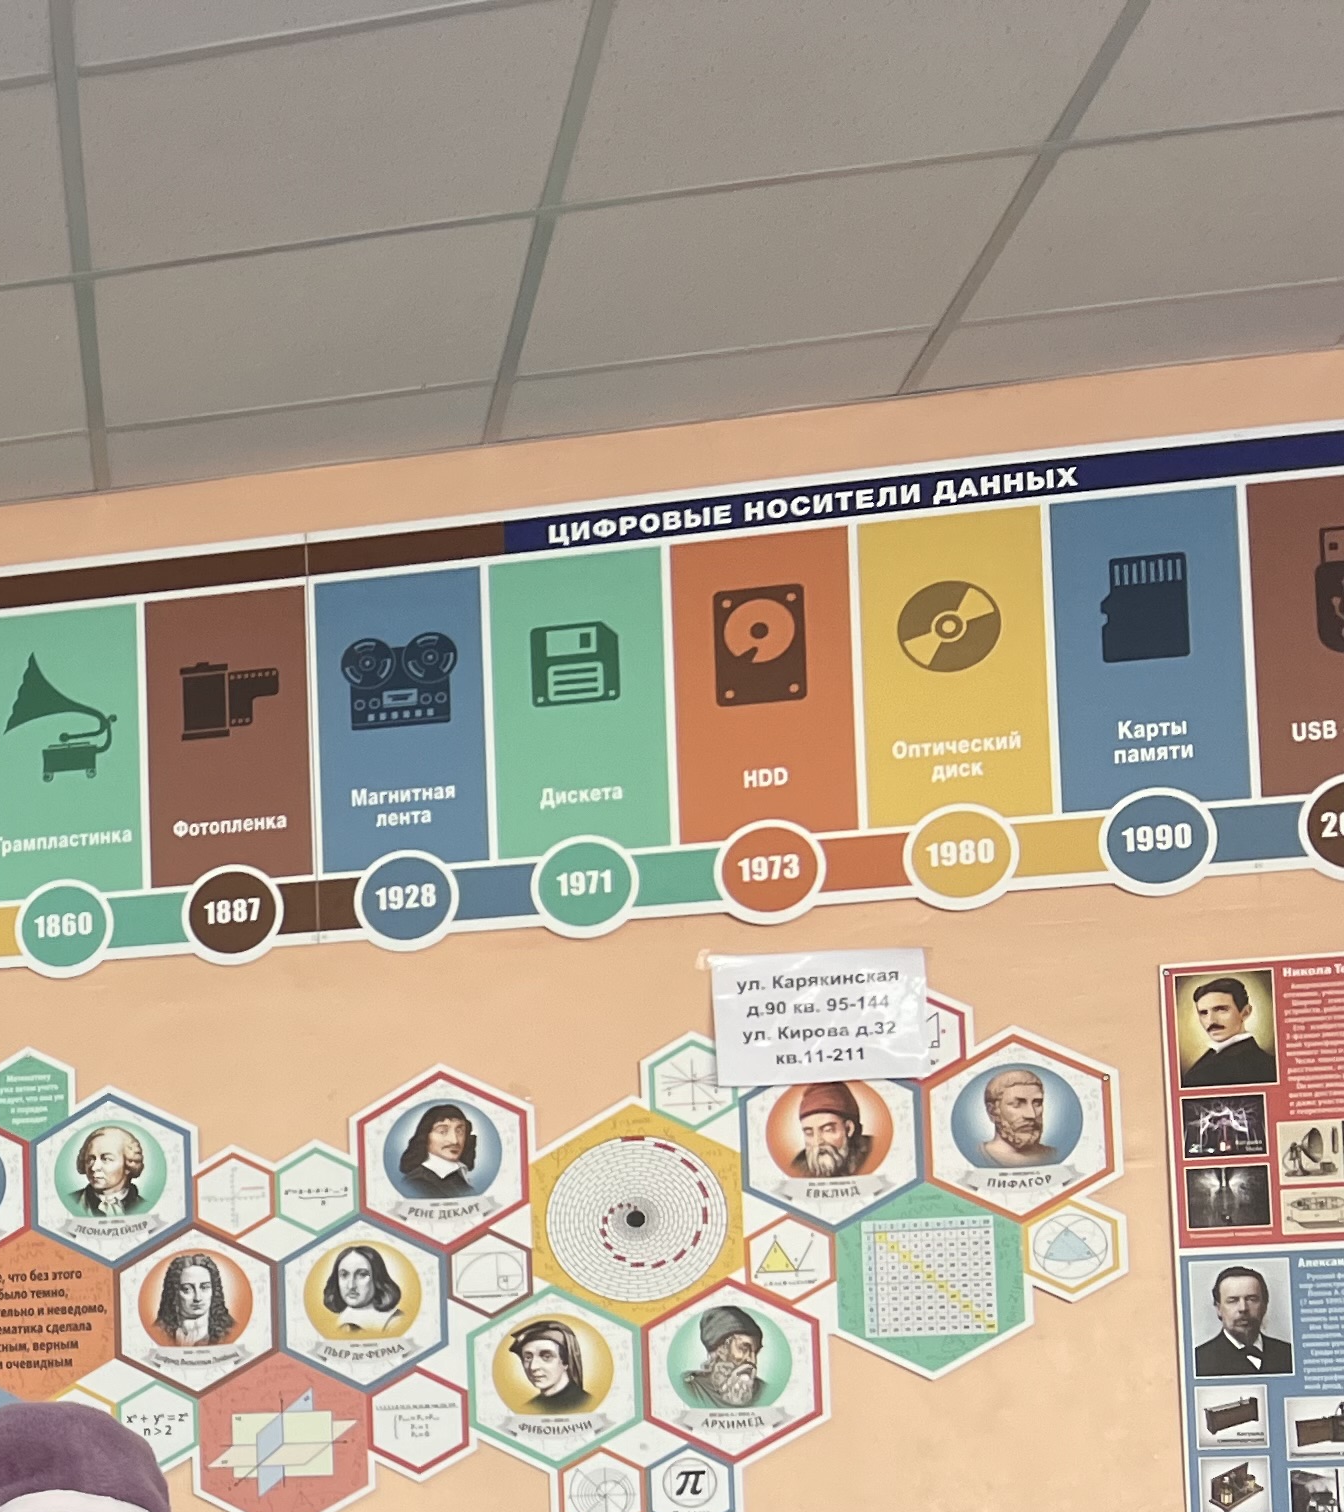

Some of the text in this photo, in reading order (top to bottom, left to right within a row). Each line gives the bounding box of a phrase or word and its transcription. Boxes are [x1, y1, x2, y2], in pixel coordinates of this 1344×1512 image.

[548, 466, 1079, 546] ЦИФРОВЫЕ НОСИТЕЛИ ДАННЫХ
[1117, 720, 1188, 743] Карты
[1291, 719, 1338, 742] USB
[892, 730, 1022, 760] Оптический
[1114, 743, 1195, 765] памяти
[743, 767, 789, 789] HDD
[931, 760, 983, 782] диск
[351, 783, 456, 808] Магнитная
[540, 785, 623, 810] Дискета
[172, 812, 288, 839] Фотопленка
[375, 808, 432, 829] лента
[1121, 823, 1193, 853] 1990
[925, 837, 996, 867] 1980
[737, 854, 801, 882] 1973
[556, 869, 612, 897] 1971
[375, 884, 437, 911] 1928
[203, 897, 262, 926] 1887
[34, 911, 94, 939] 1860
[736, 970, 900, 995] ул. Карякинская
[1282, 964, 1332, 978] Никола
[746, 994, 890, 1018] д.90 кв. 95-144
[742, 1021, 897, 1045] ул. Кирова д.32
[987, 1174, 1053, 1189] ПИФАГОР
[438, 1202, 481, 1219] ДЕКАРТ
[8, 1273, 27, 1283] что
[29, 1269, 49, 1282] без
[52, 1269, 82, 1282] этого
[31, 1288, 68, 1299] темно,
[37, 1307, 45, 1317] и
[47, 1303, 108, 1317] неведомо,
[46, 1321, 92, 1335] сделала
[32, 1340, 79, 1354] верным
[6, 1357, 73, 1370] очевидным
[701, 1416, 765, 1430] АРХИМЕД
